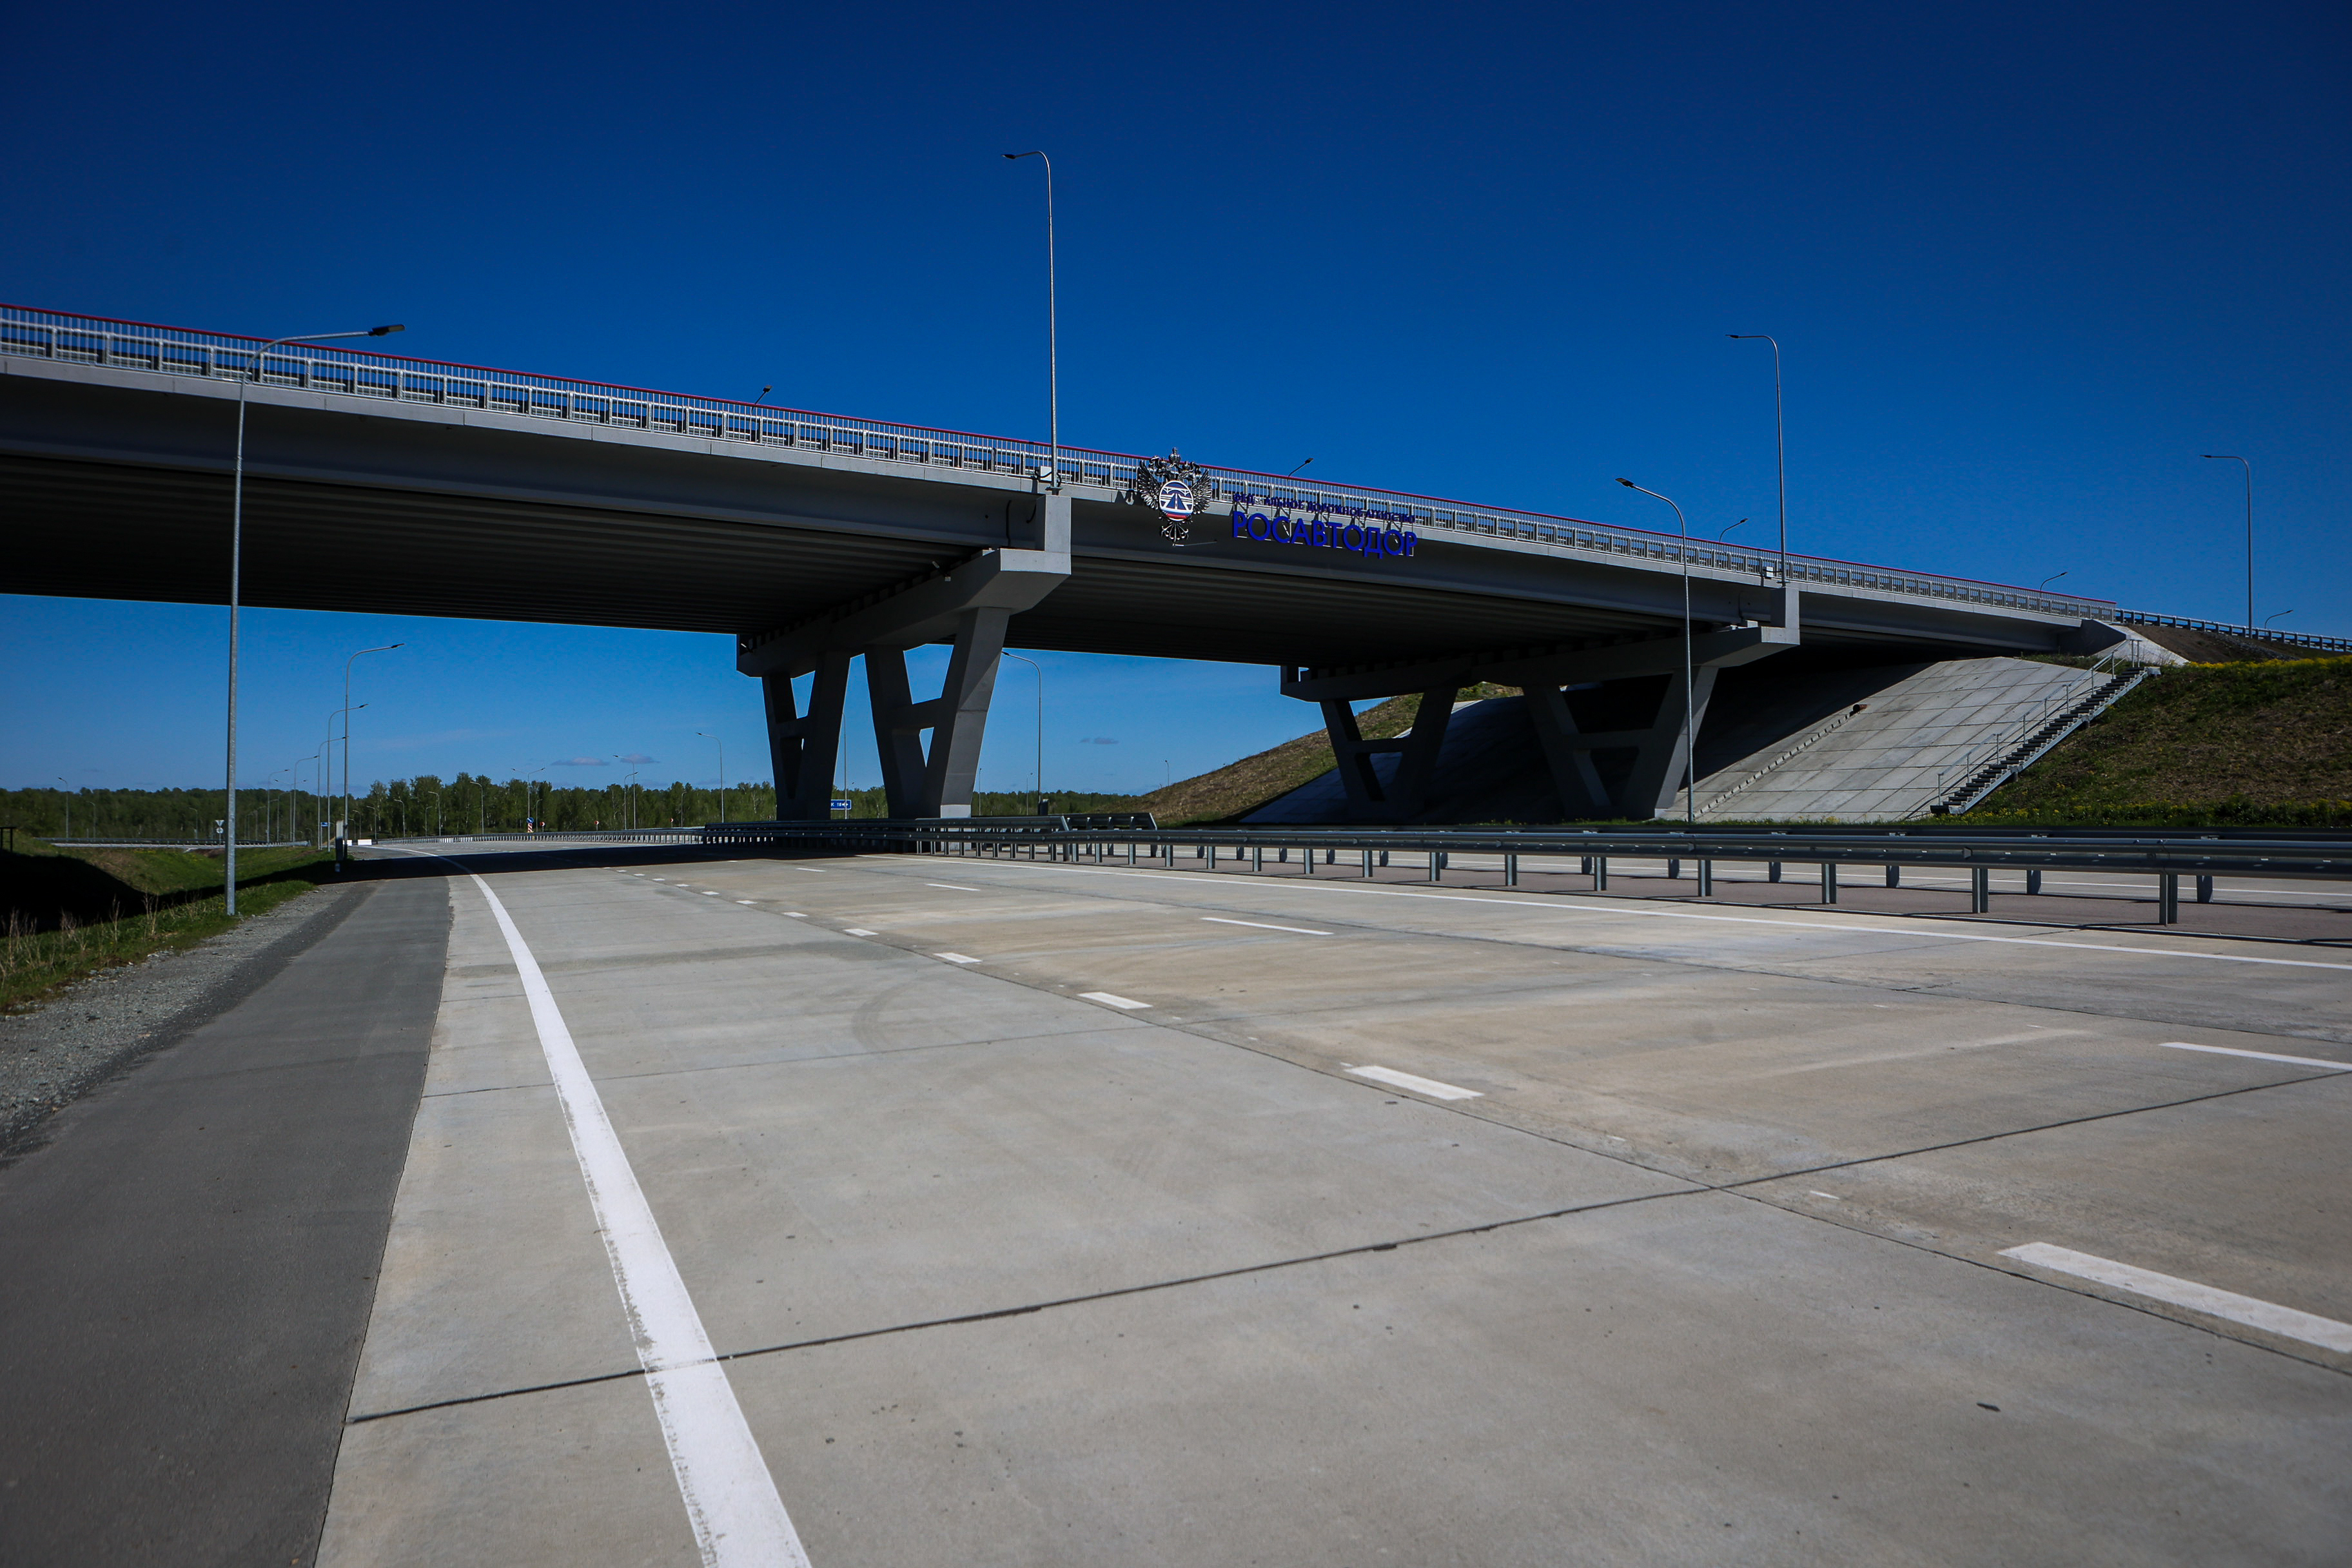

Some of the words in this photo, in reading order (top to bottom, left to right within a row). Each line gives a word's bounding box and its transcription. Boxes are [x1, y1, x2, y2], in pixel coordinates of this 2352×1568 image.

[1233, 493, 1304, 509] ФЕДАЛЬНОЕ
[1308, 502, 1362, 518] ДОРОЖНОЕ
[1366, 509, 1416, 524] АГЕНТСТВО
[1233, 511, 1417, 559] РОСАВТОДОР
